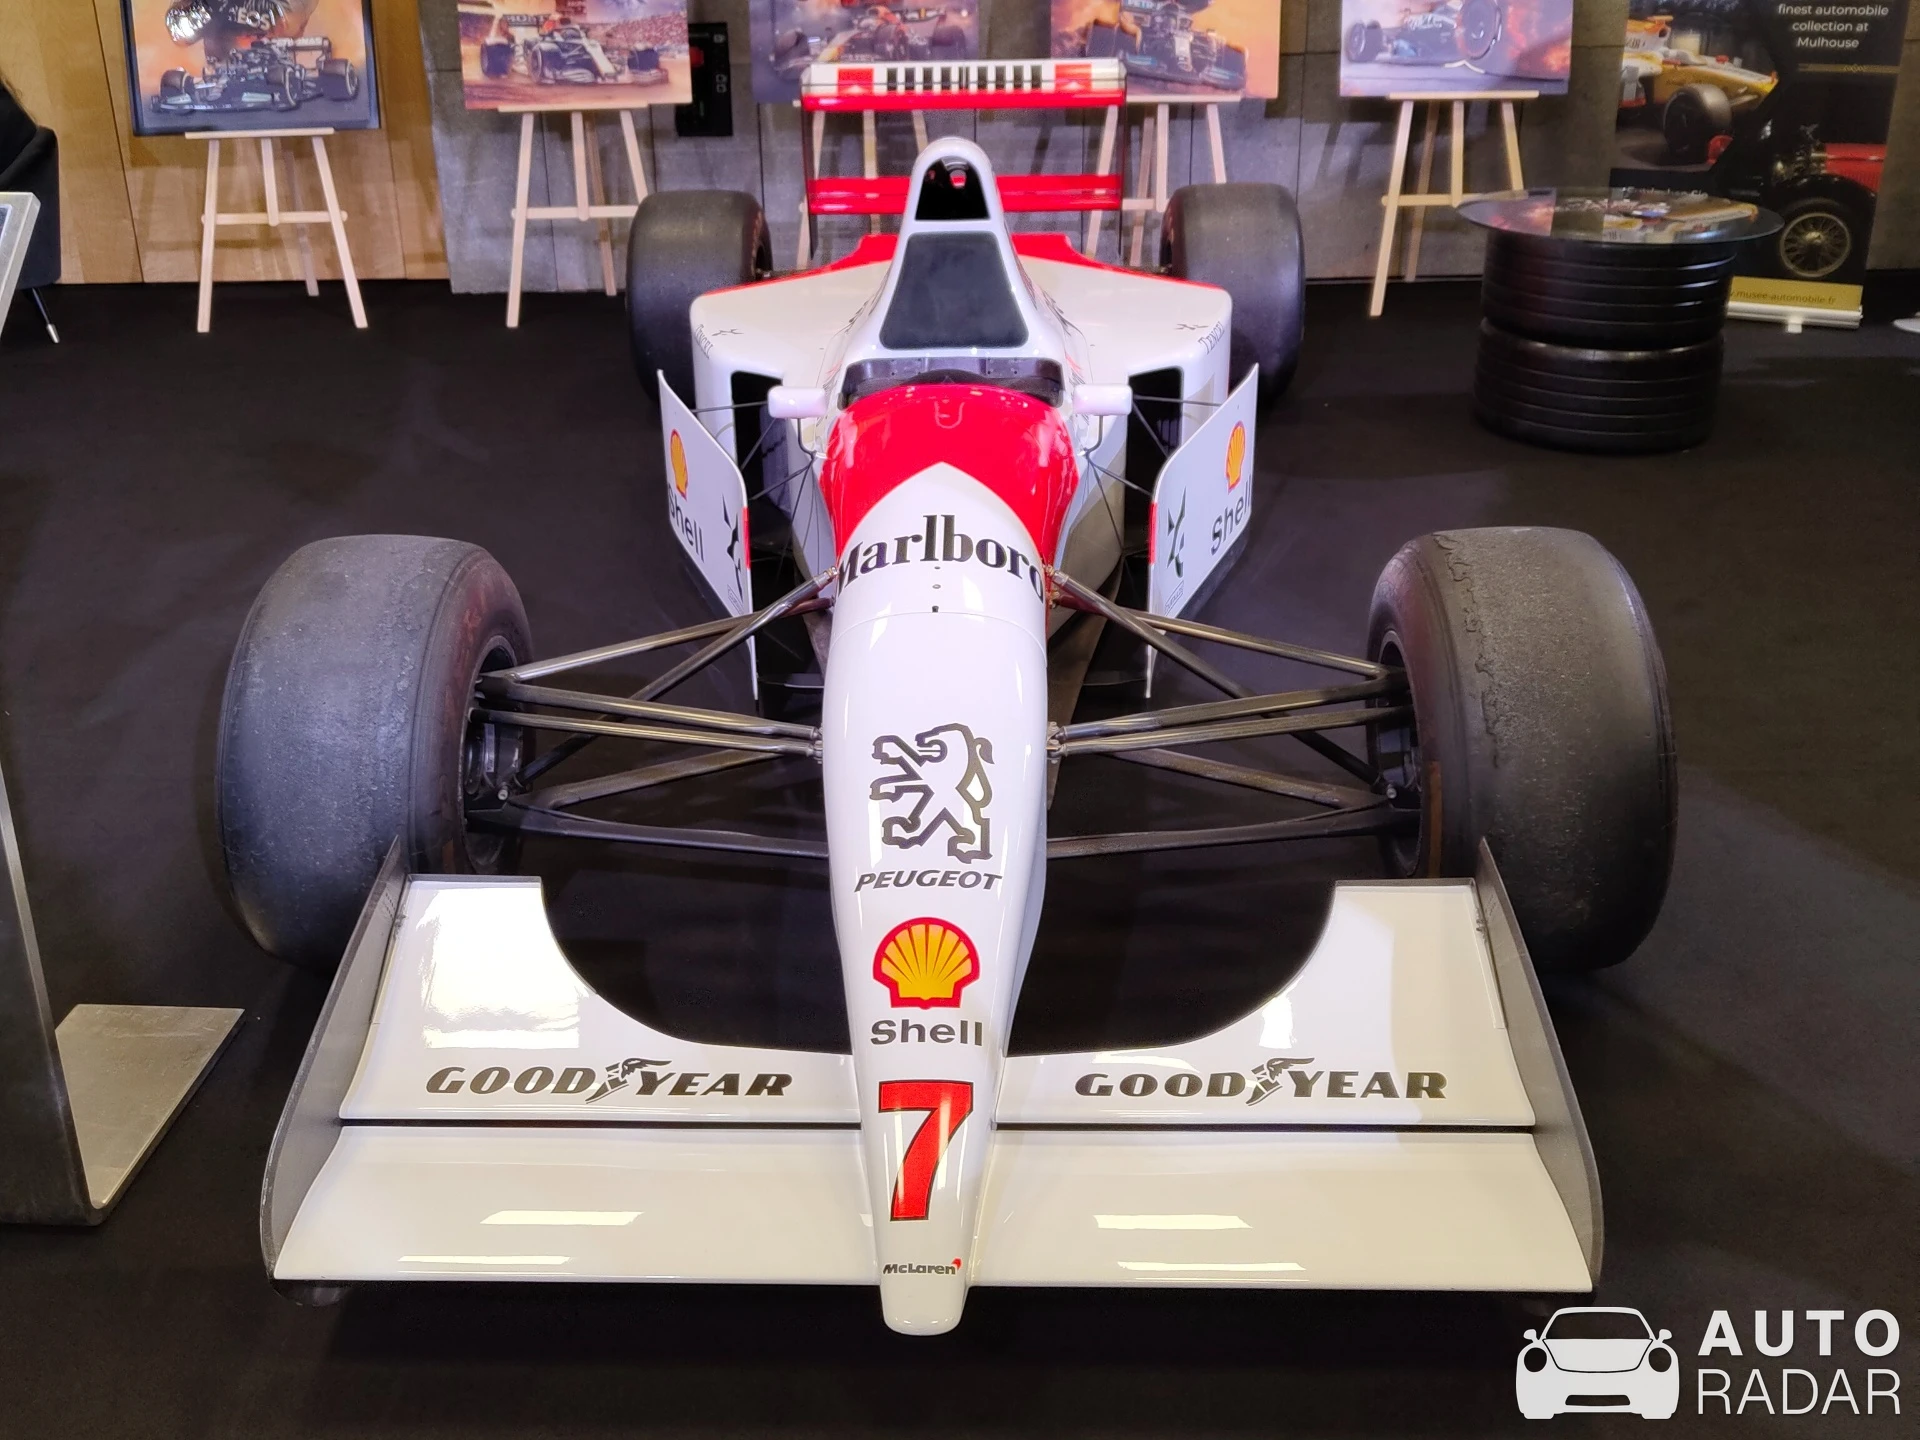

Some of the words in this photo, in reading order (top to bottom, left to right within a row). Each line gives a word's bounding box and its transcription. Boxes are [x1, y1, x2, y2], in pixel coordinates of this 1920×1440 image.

[1778, 3, 1812, 15] finest
[1815, 4, 1889, 16] automobile
[1792, 20, 1852, 32] collection
[1856, 22, 1869, 32] at
[1797, 36, 1859, 48] Mulhouse
[668, 483, 705, 564] Shell
[1210, 473, 1252, 557] Shell
[837, 514, 1044, 604] Marlboro
[854, 869, 1003, 893] PEUGEOT
[870, 1018, 983, 1047] Shell
[878, 1079, 974, 1222] 7
[883, 1262, 957, 1275] McLaren
